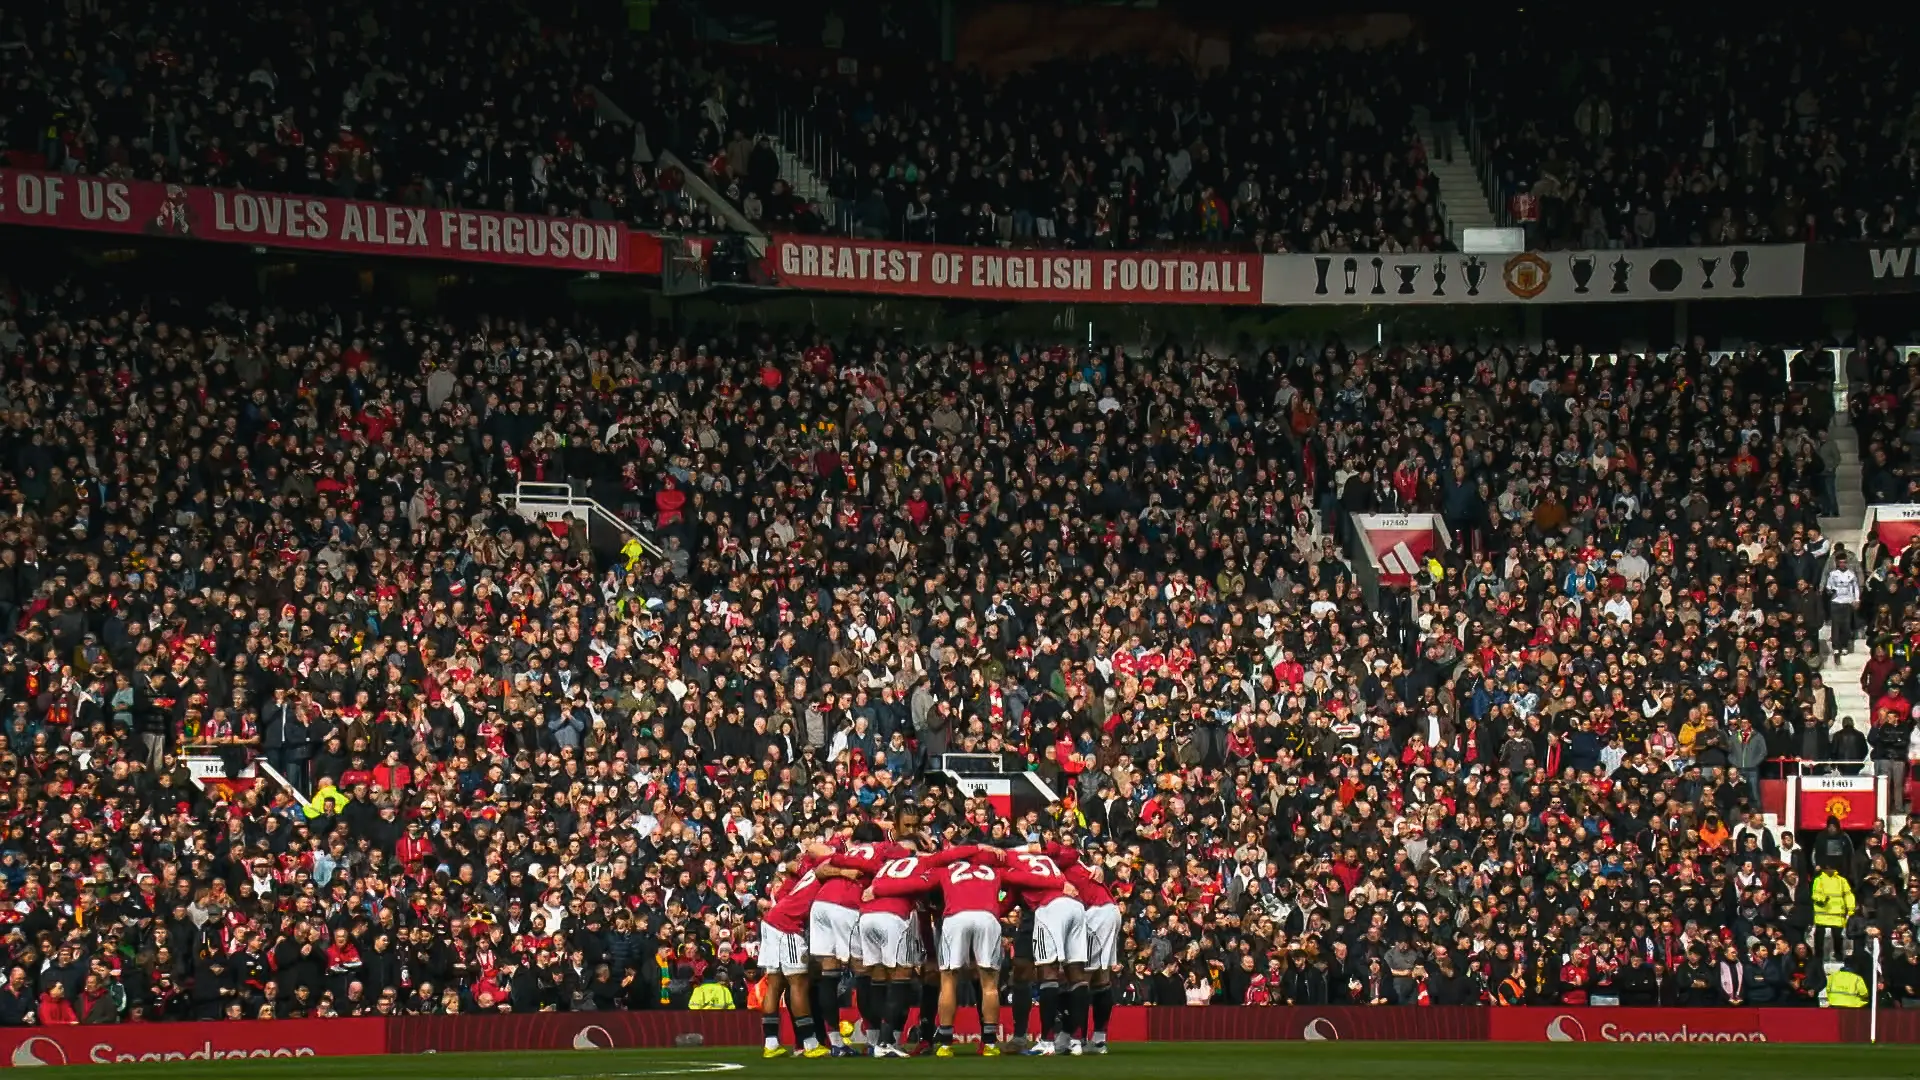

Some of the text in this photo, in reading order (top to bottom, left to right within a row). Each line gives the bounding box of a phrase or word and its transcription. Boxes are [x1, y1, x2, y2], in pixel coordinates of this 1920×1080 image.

[17, 174, 64, 215] OF
[78, 179, 130, 222] US
[213, 191, 328, 240] LOVES
[340, 204, 429, 246] ALEX
[440, 211, 617, 262] FERGUSON
[781, 242, 1250, 292] GREATEST OF ENGLISH FOOTBALL
[876, 857, 919, 879] 10
